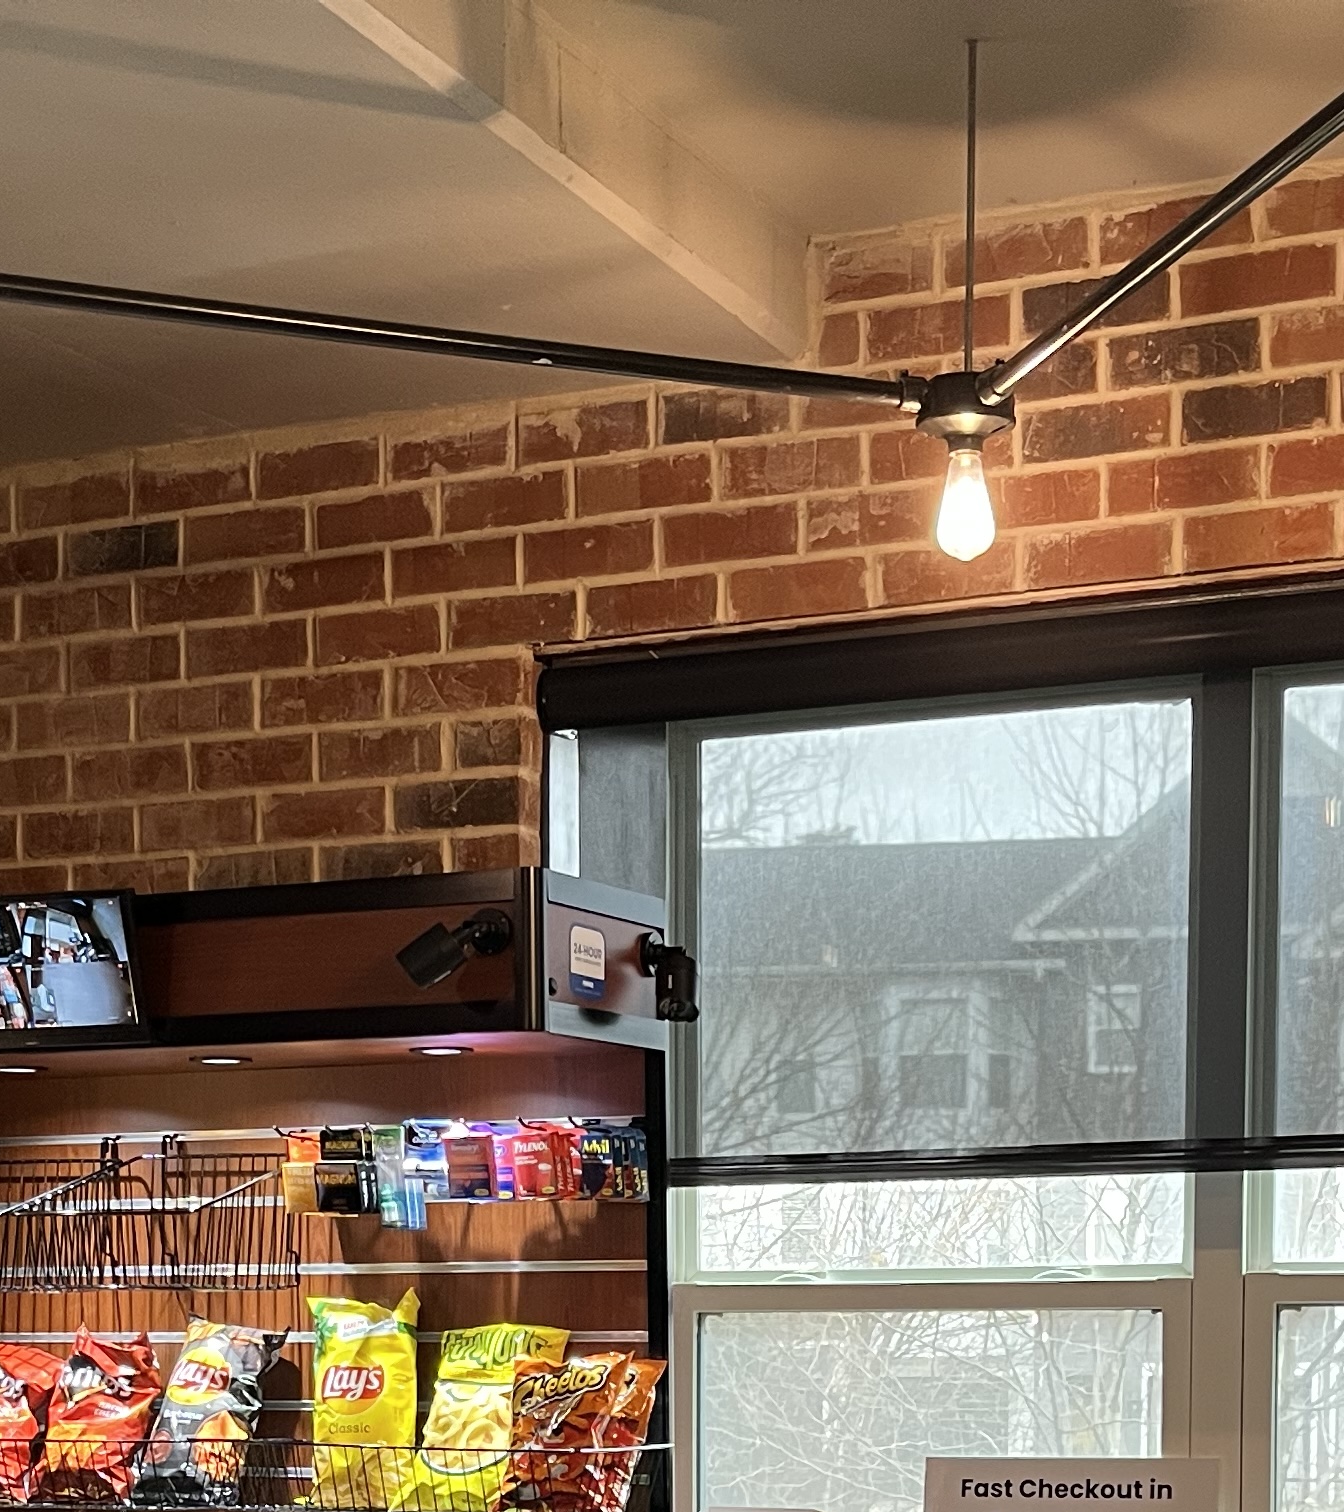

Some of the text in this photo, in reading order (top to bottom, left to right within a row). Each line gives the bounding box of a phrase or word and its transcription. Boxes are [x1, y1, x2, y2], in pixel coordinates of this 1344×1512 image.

[514, 1141, 549, 1153] TYLENOL
[582, 1139, 609, 1153] Advil
[323, 1364, 383, 1401] Lay's
[513, 1365, 607, 1414] Cheetos
[328, 1422, 372, 1434] Classic
[961, 1478, 1172, 1499] Fast Checkout in
